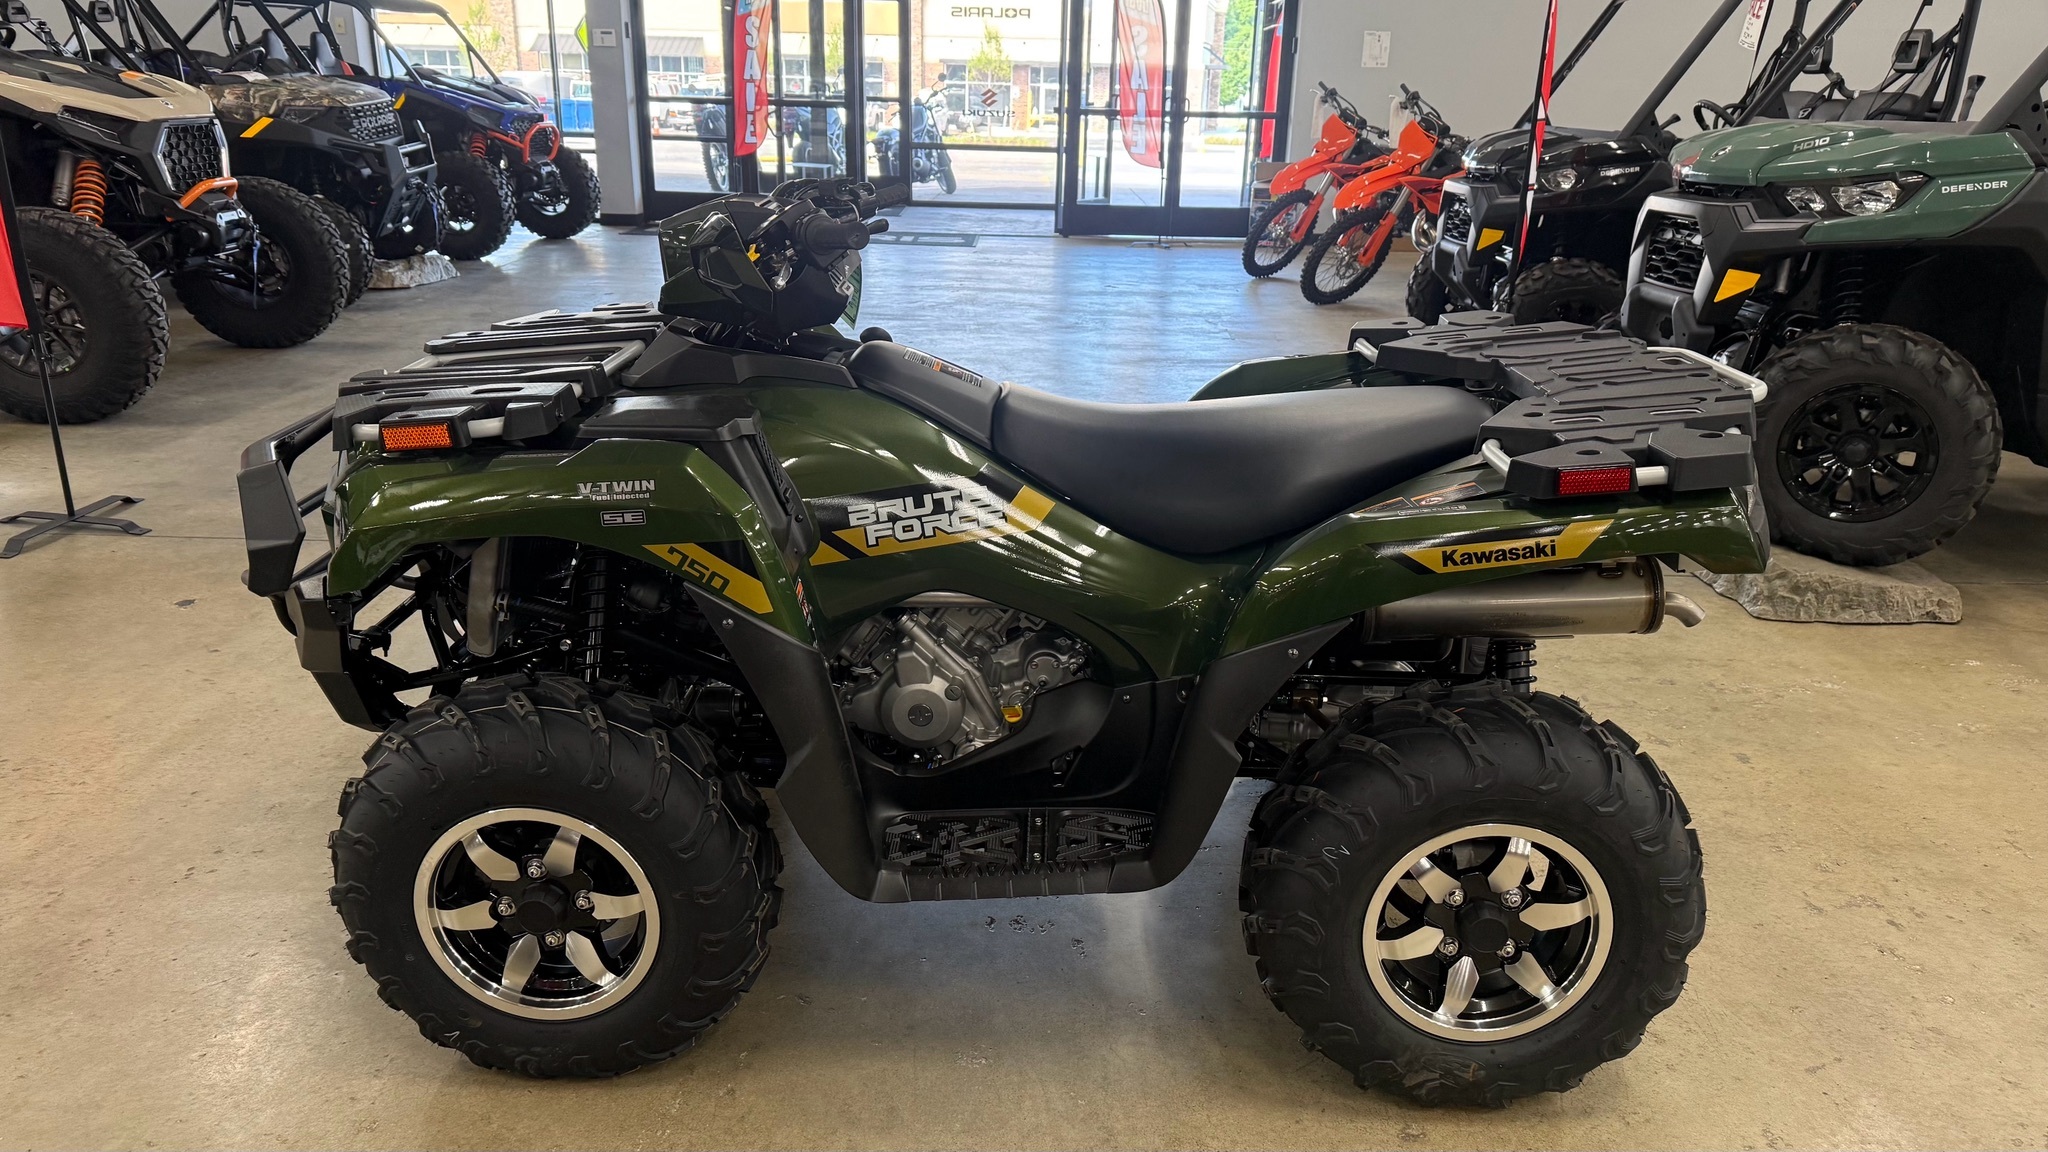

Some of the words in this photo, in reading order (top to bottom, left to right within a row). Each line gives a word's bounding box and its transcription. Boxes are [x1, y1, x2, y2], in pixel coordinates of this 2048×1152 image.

[1792, 136, 1830, 152] HD10
[1600, 166, 1640, 177] DEFENDER
[1941, 180, 2009, 194] DEFENDER
[577, 479, 656, 494] V-TWIN
[613, 492, 650, 501] Injected
[847, 485, 992, 527] BRUTE
[603, 512, 644, 524] SE
[866, 505, 1007, 546] FORCE
[1441, 539, 1557, 568] Kawasaki
[666, 545, 731, 595] 750
